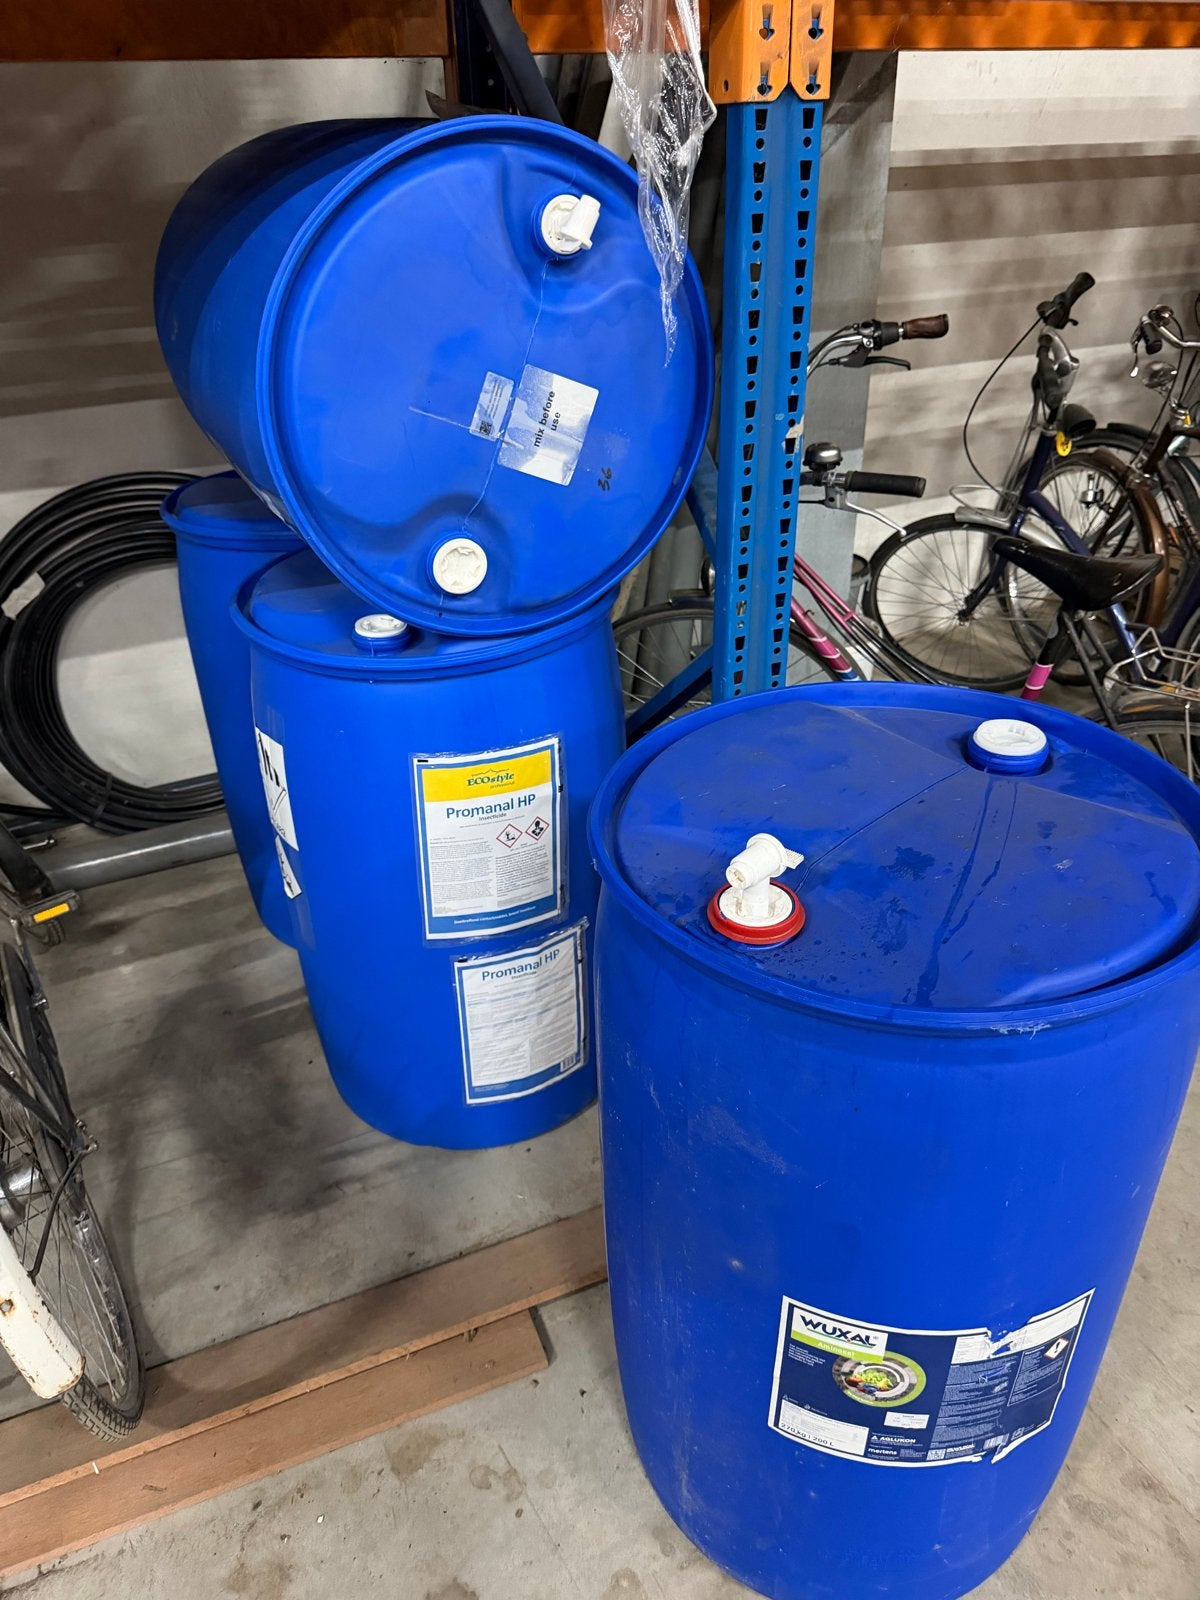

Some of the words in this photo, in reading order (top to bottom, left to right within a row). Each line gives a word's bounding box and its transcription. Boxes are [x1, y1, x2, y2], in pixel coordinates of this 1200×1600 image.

[538, 390, 557, 426] before
[550, 410, 562, 432] use
[532, 427, 545, 448] mix
[467, 772, 514, 787] ECOstyle
[446, 798, 514, 819] Promanal
[518, 793, 536, 807] HP
[478, 812, 507, 821] Insecticide
[482, 957, 542, 981] Promanal
[544, 949, 560, 964] HP
[800, 1314, 876, 1347] WUXAL
[780, 1423, 796, 1434] 270
[812, 1436, 828, 1445] 200
[880, 1436, 916, 1444] AGLUKON
[868, 1447, 897, 1456] mertens
